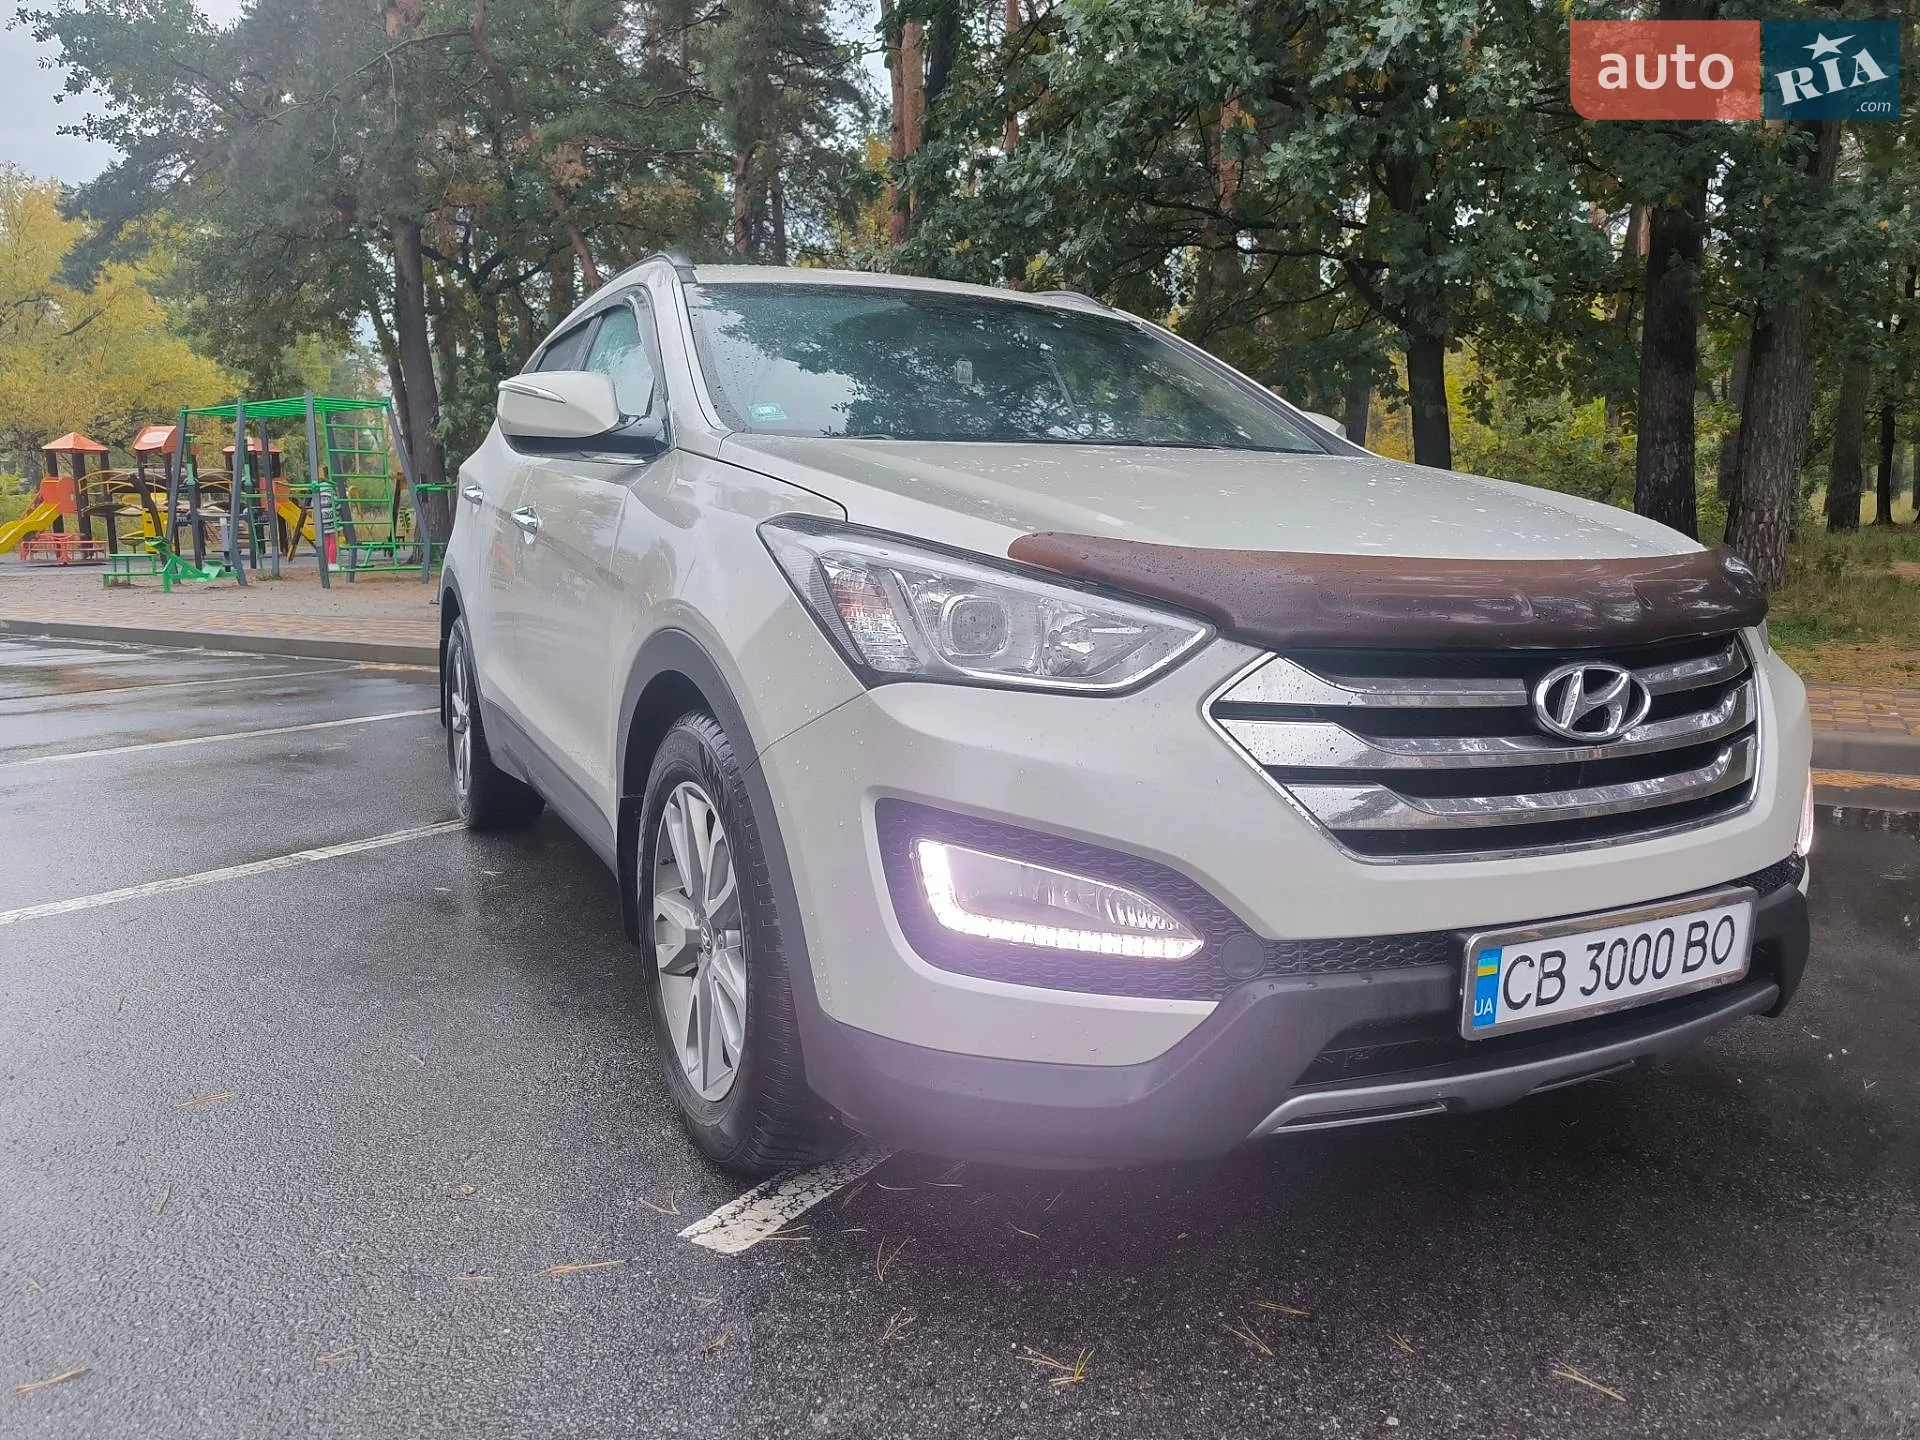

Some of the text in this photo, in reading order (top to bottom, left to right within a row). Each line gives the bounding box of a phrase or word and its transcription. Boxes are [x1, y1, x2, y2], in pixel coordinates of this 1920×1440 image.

[1502, 914, 1736, 1011] CB 3000 BO
[1473, 996, 1494, 1017] UA
